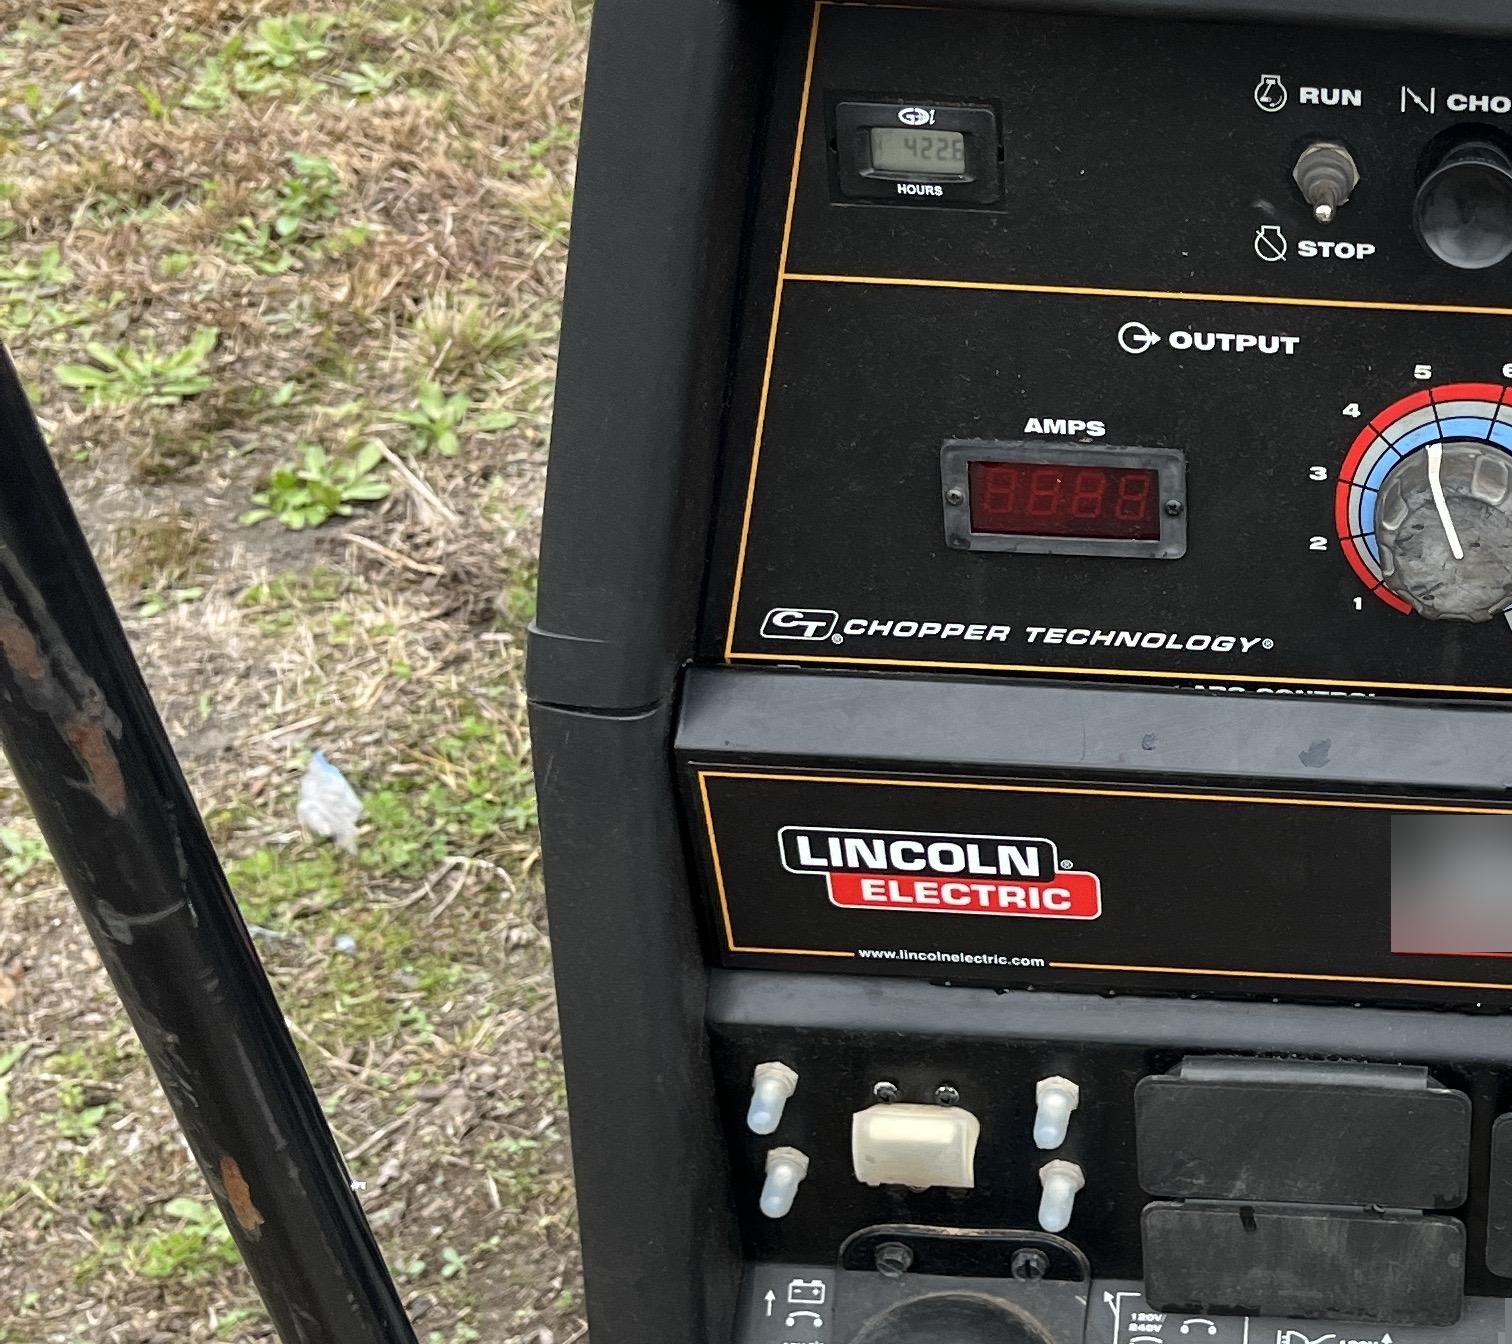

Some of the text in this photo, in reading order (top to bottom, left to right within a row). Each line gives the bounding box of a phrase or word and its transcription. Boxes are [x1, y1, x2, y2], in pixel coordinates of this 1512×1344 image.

[1299, 87, 1363, 108] RUN
[897, 184, 943, 196] HOURS
[1298, 240, 1376, 260] STOP
[1168, 331, 1300, 356] OUTPUT
[1413, 365, 1433, 380] 5
[1342, 402, 1361, 419] 4
[1024, 417, 1106, 437] AMPS
[1308, 465, 1328, 481] 3
[1308, 536, 1328, 551] 2
[1352, 597, 1363, 610] 1
[843, 619, 1011, 642] CHOPPER
[796, 834, 1041, 878] LINCOLN
[861, 879, 1072, 911] ELECTRIC
[858, 947, 1045, 968] www.lincolnelectric.com
